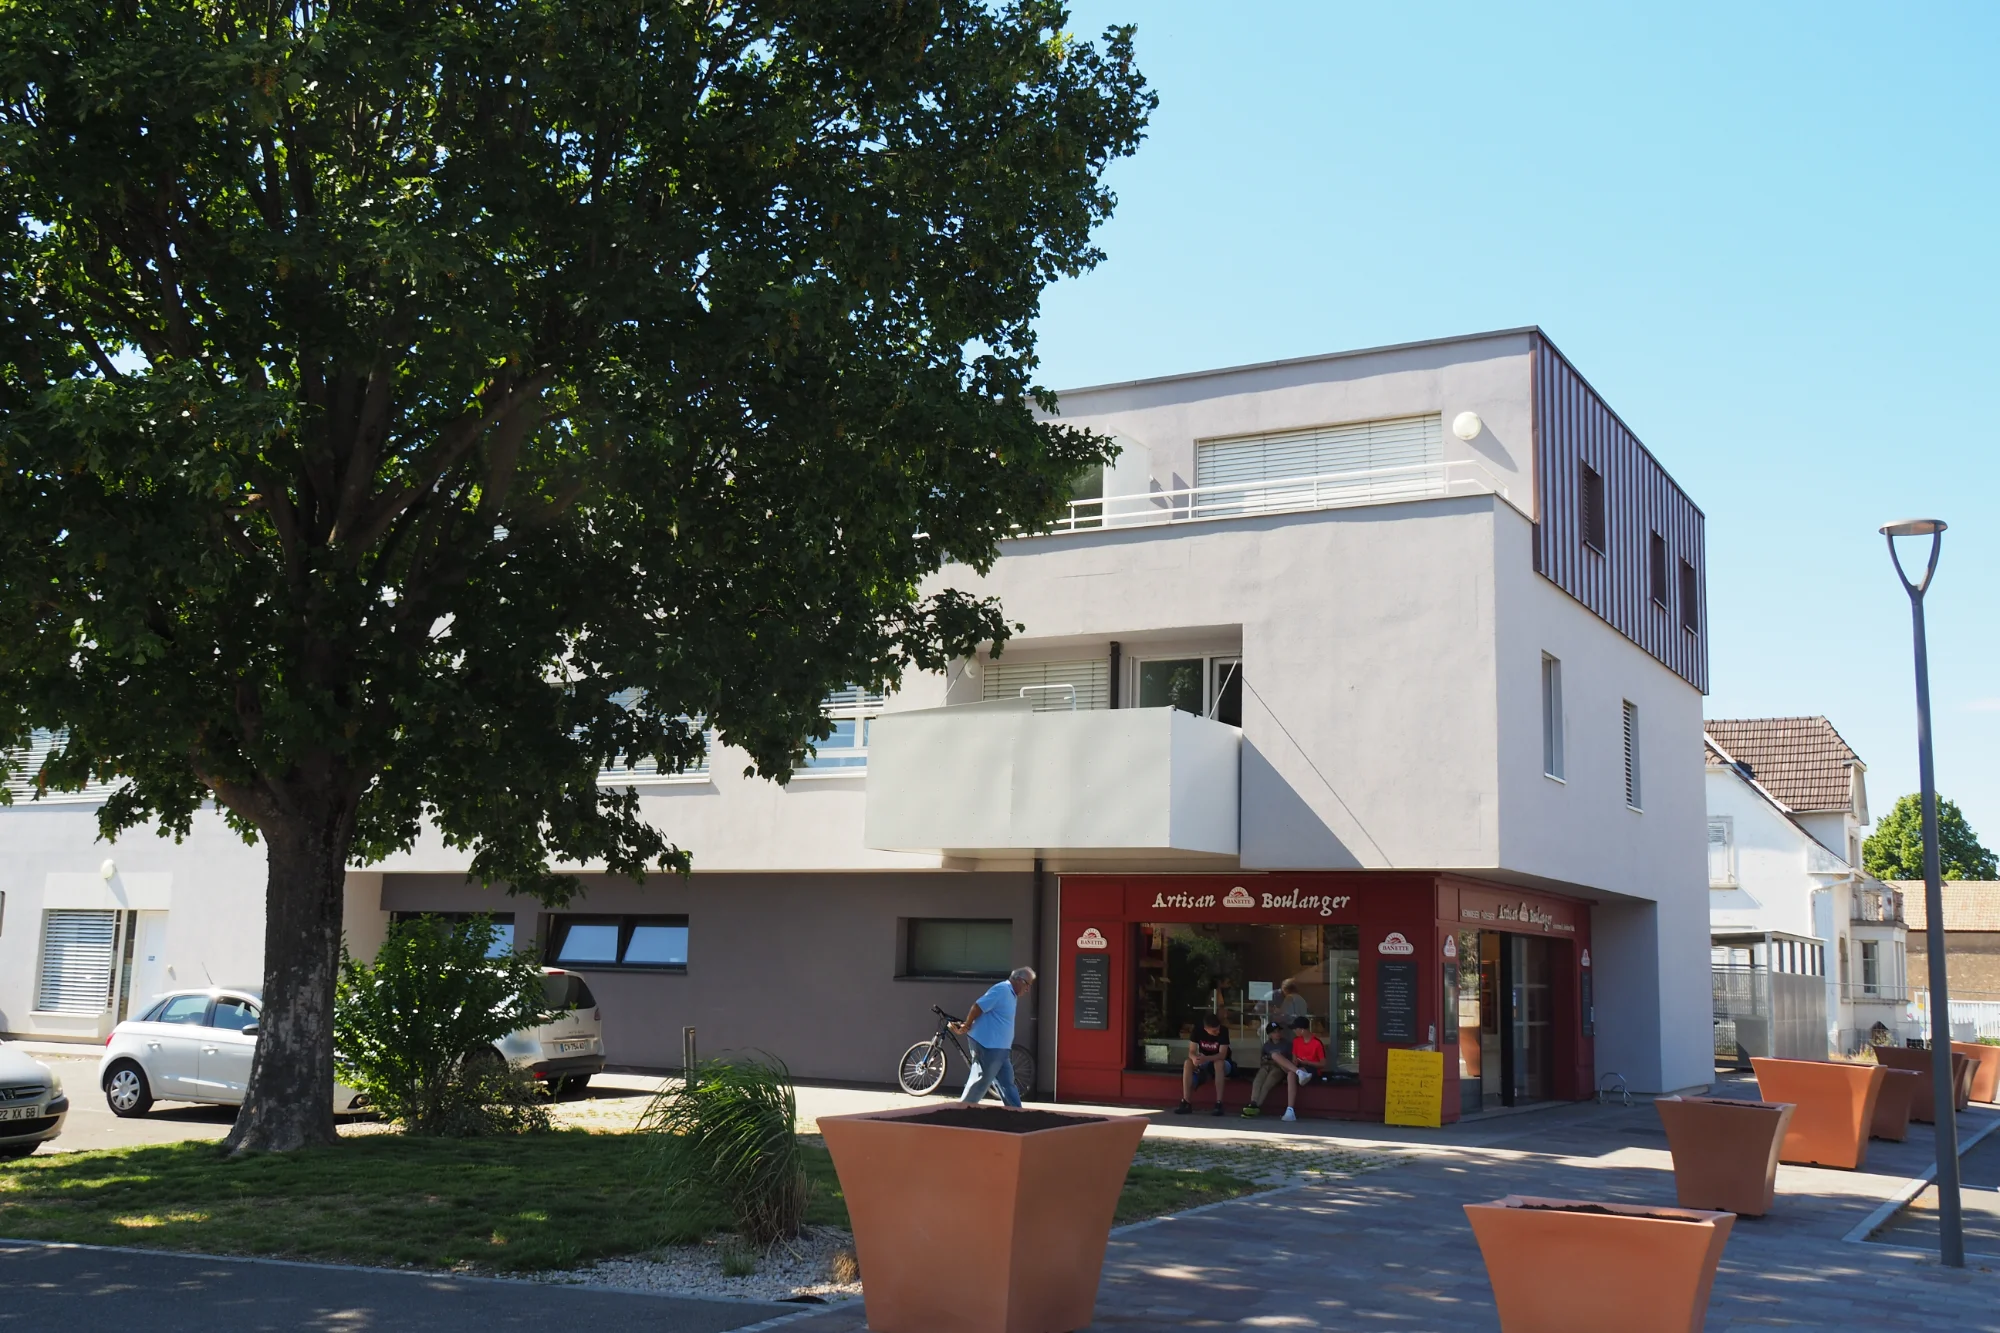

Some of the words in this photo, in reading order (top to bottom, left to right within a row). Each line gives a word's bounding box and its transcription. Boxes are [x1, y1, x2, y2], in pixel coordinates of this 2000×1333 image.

[1152, 891, 1216, 908] Artisan
[1261, 888, 1350, 916] Boulanger
[12, 1109, 22, 1119] XX
[26, 1107, 36, 1118] 68
